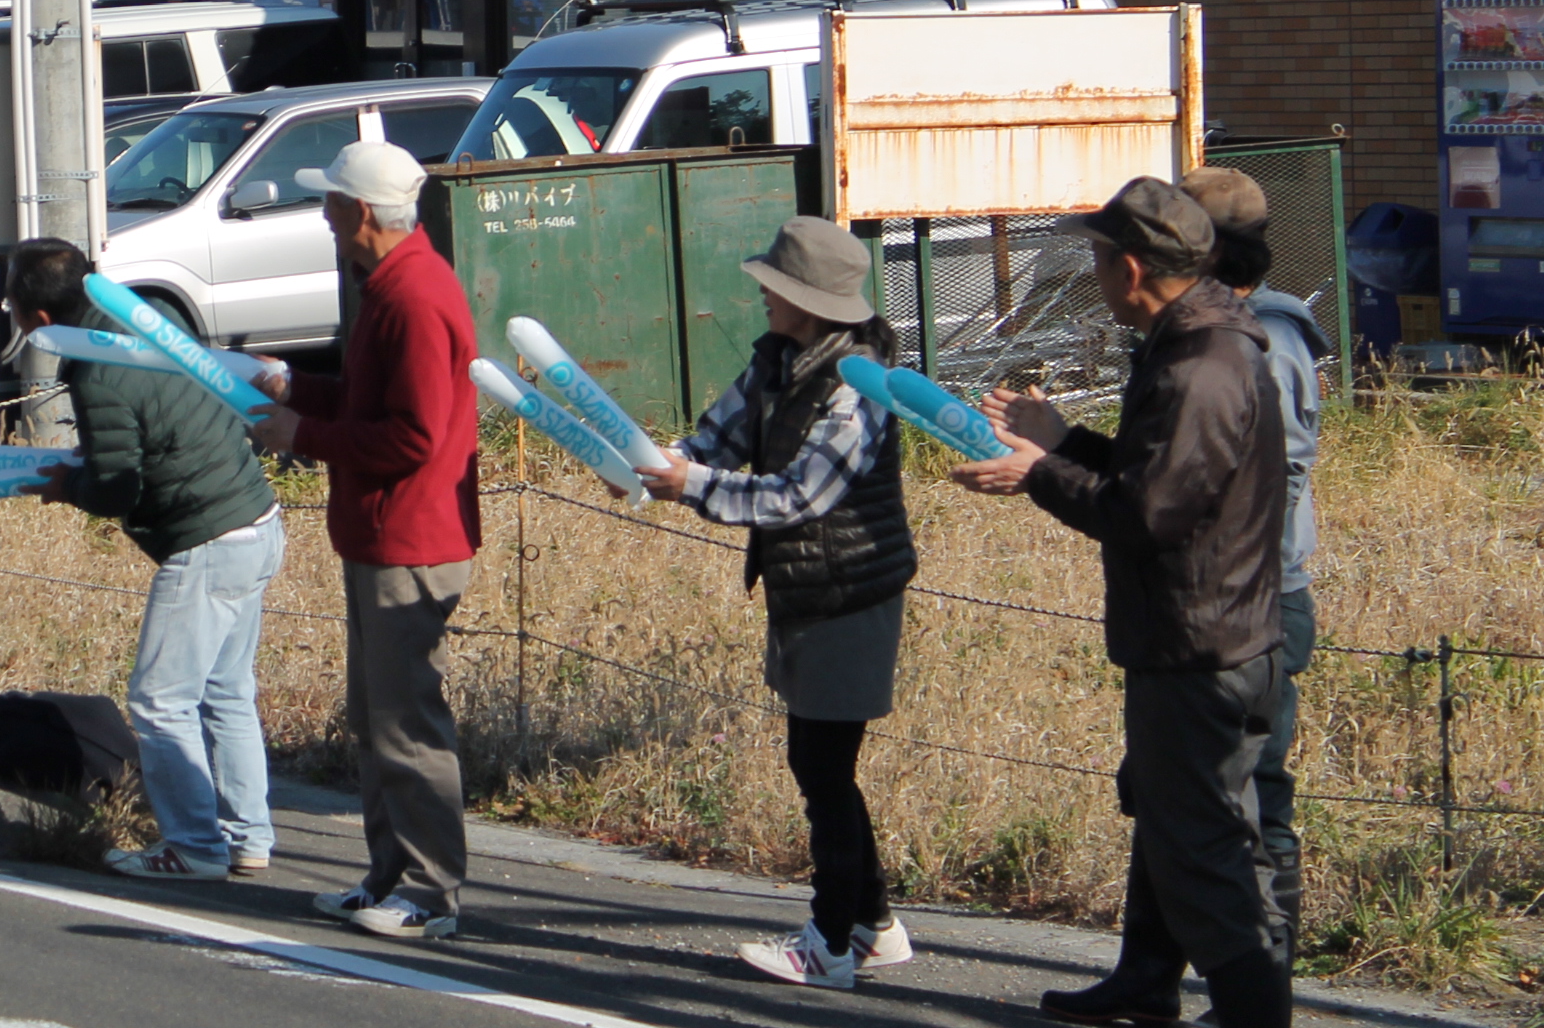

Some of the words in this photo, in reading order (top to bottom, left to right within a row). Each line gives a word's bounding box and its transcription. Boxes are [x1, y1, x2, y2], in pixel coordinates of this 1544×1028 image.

[484, 221, 509, 233] TEL
[156, 324, 235, 394] STARTS
[536, 407, 605, 467] STARTS
[565, 381, 634, 449] STARTS
